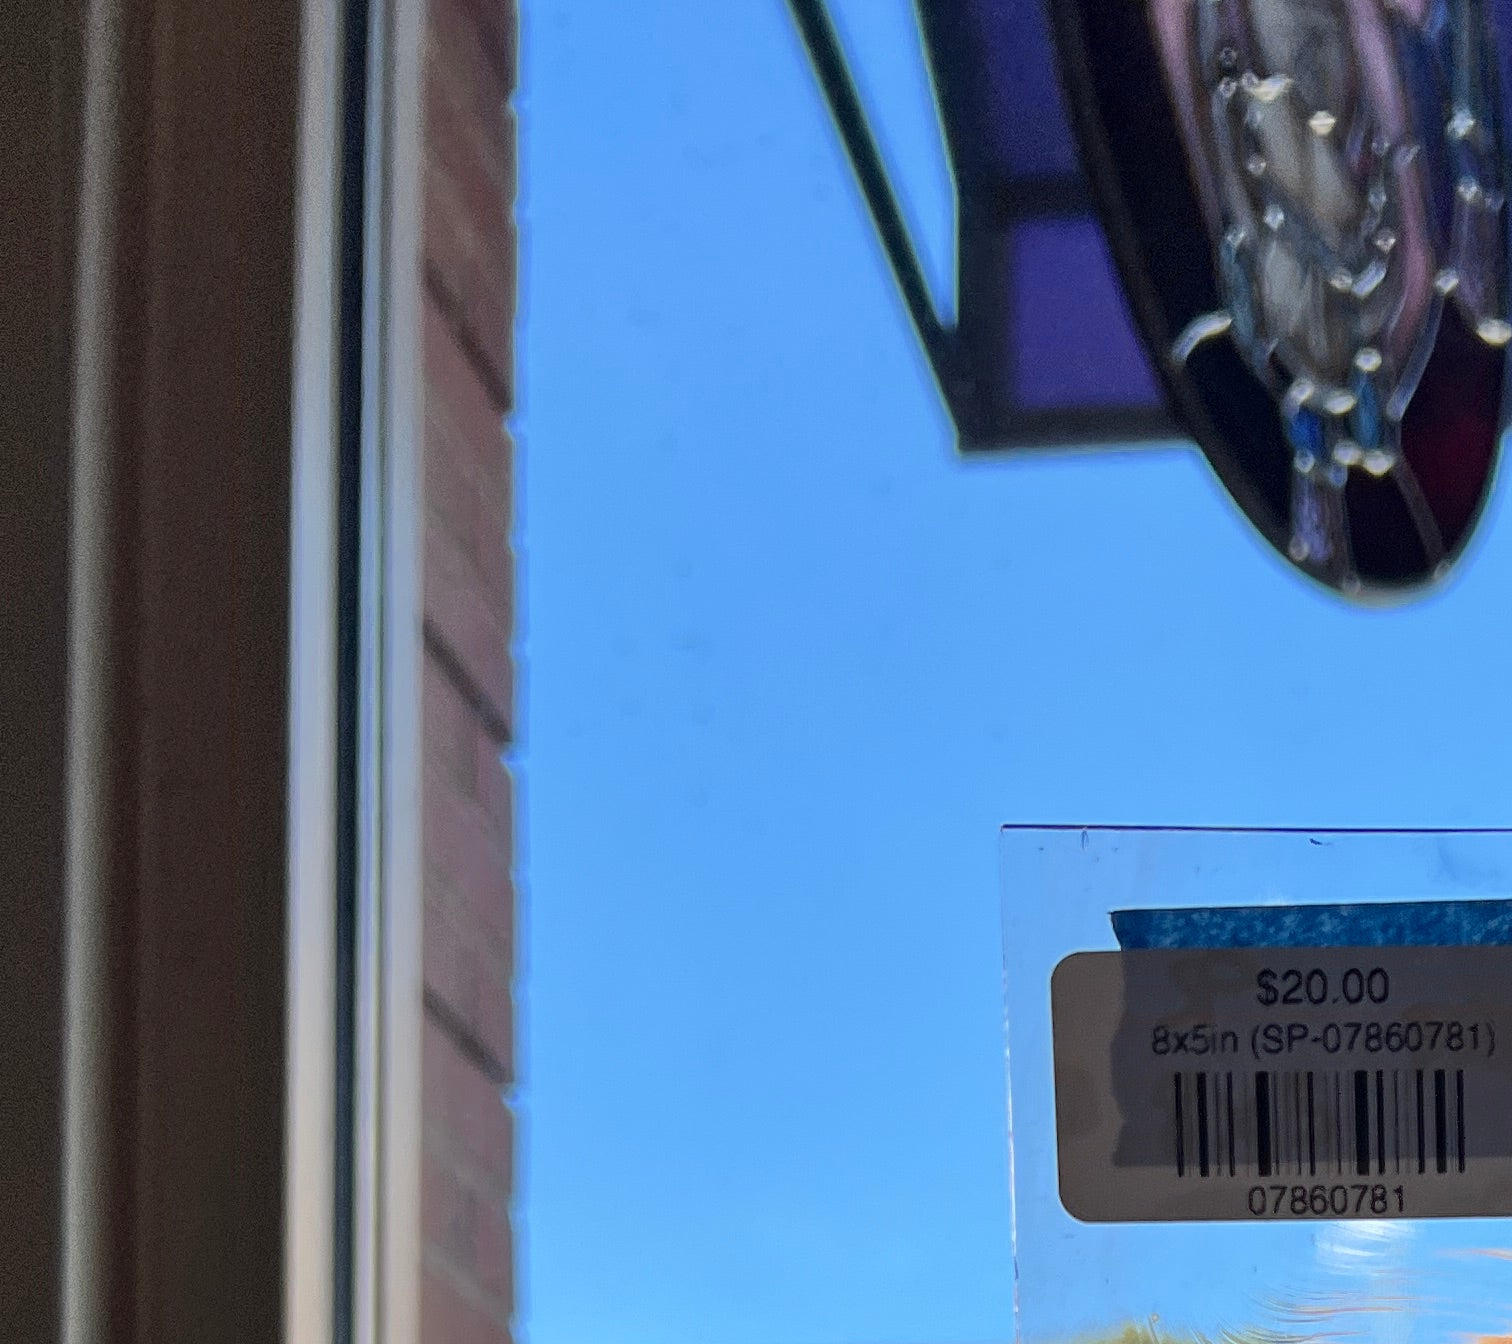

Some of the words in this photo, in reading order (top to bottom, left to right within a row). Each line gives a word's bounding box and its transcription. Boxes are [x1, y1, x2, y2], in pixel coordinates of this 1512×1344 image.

[1256, 967, 1390, 1006] $20.00
[1151, 1024, 1239, 1055] 8x5in
[1251, 1019, 1496, 1060] (SP-07860781)
[1248, 1184, 1404, 1215] 07860781
